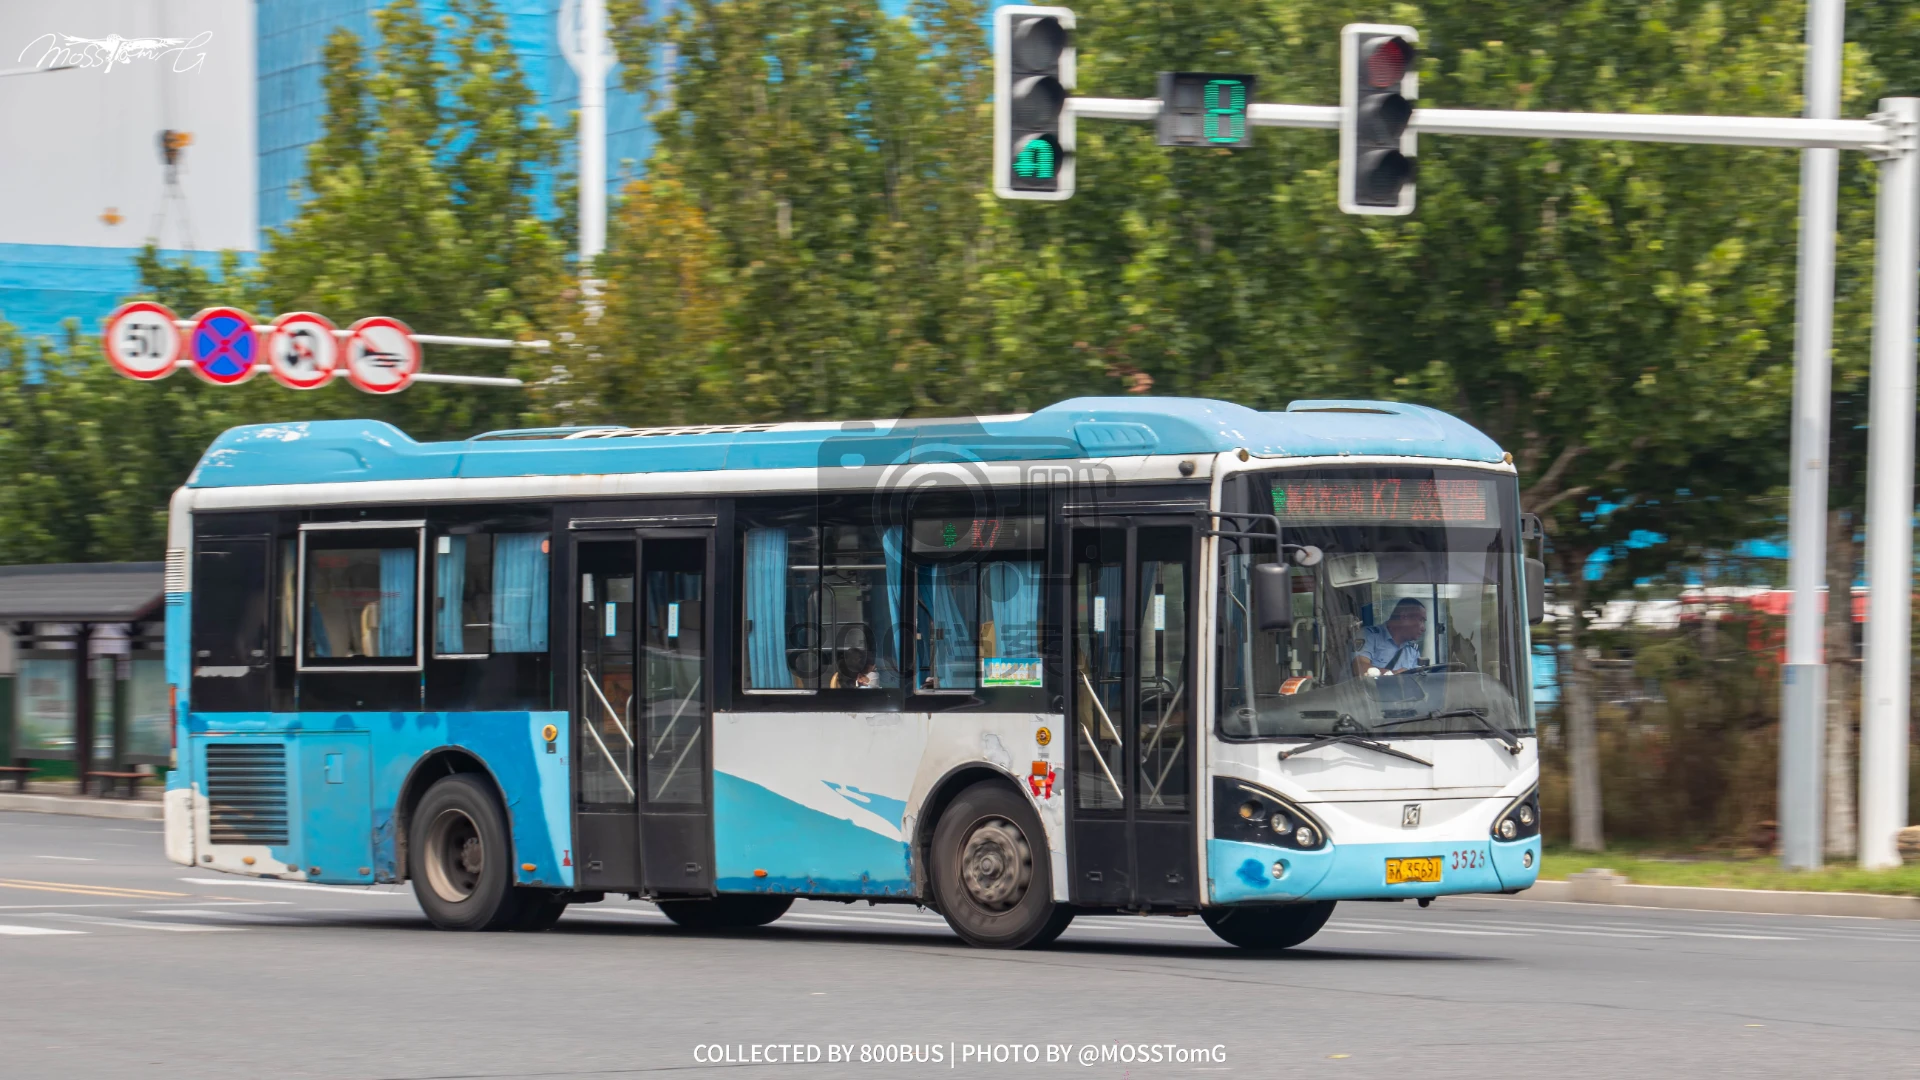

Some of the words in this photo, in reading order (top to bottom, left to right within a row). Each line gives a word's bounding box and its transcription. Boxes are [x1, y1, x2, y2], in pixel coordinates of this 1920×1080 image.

[125, 322, 164, 358] 50
[1371, 478, 1401, 519] K7
[972, 519, 999, 548] K7
[1451, 850, 1485, 870] 3525
